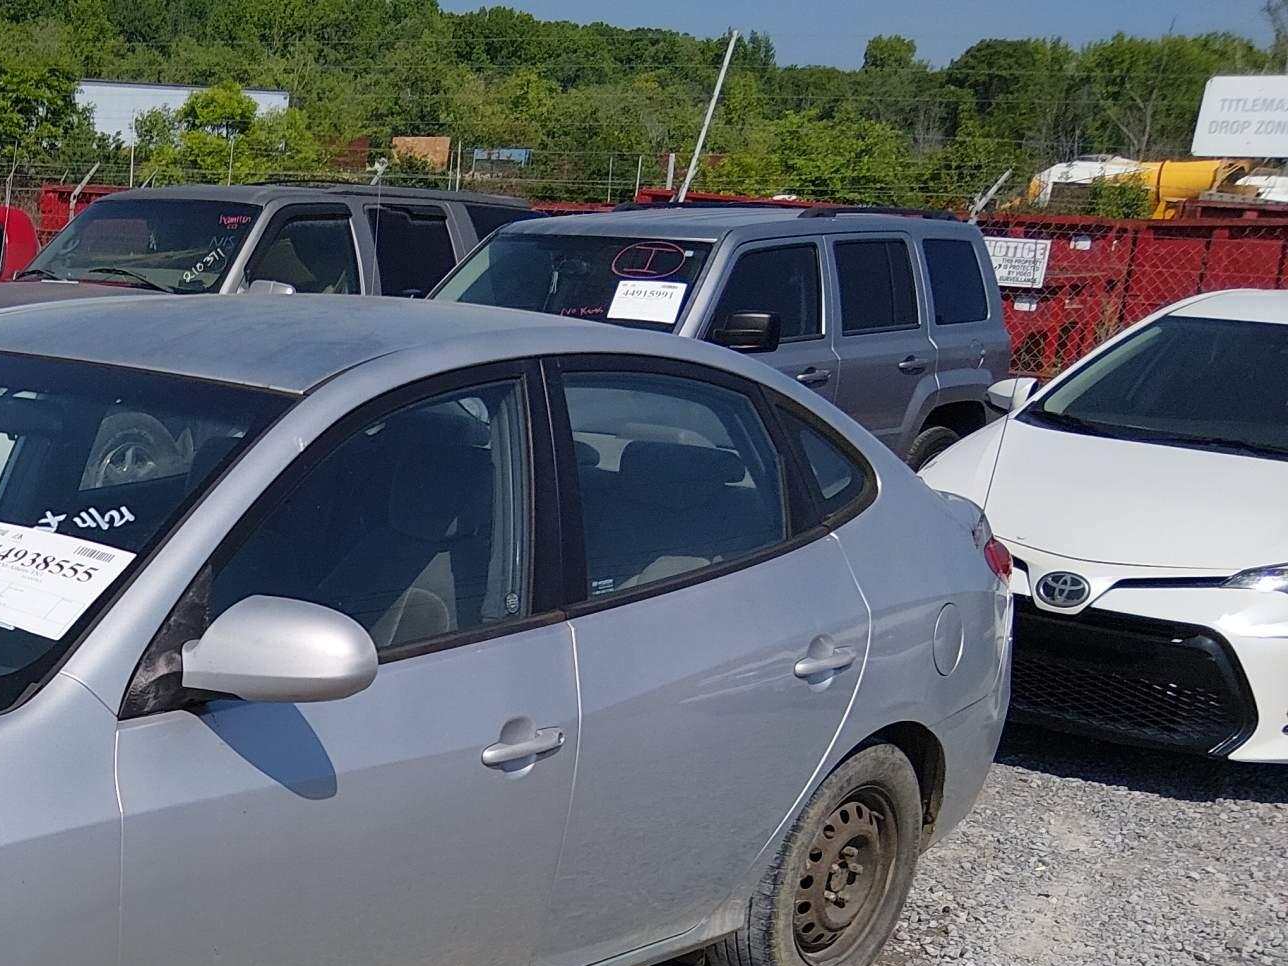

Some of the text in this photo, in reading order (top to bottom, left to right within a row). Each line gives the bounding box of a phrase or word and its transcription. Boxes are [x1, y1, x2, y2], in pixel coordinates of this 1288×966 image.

[1219, 98, 1288, 113] TITLEMA
[1208, 120, 1288, 135] DROP ZON
